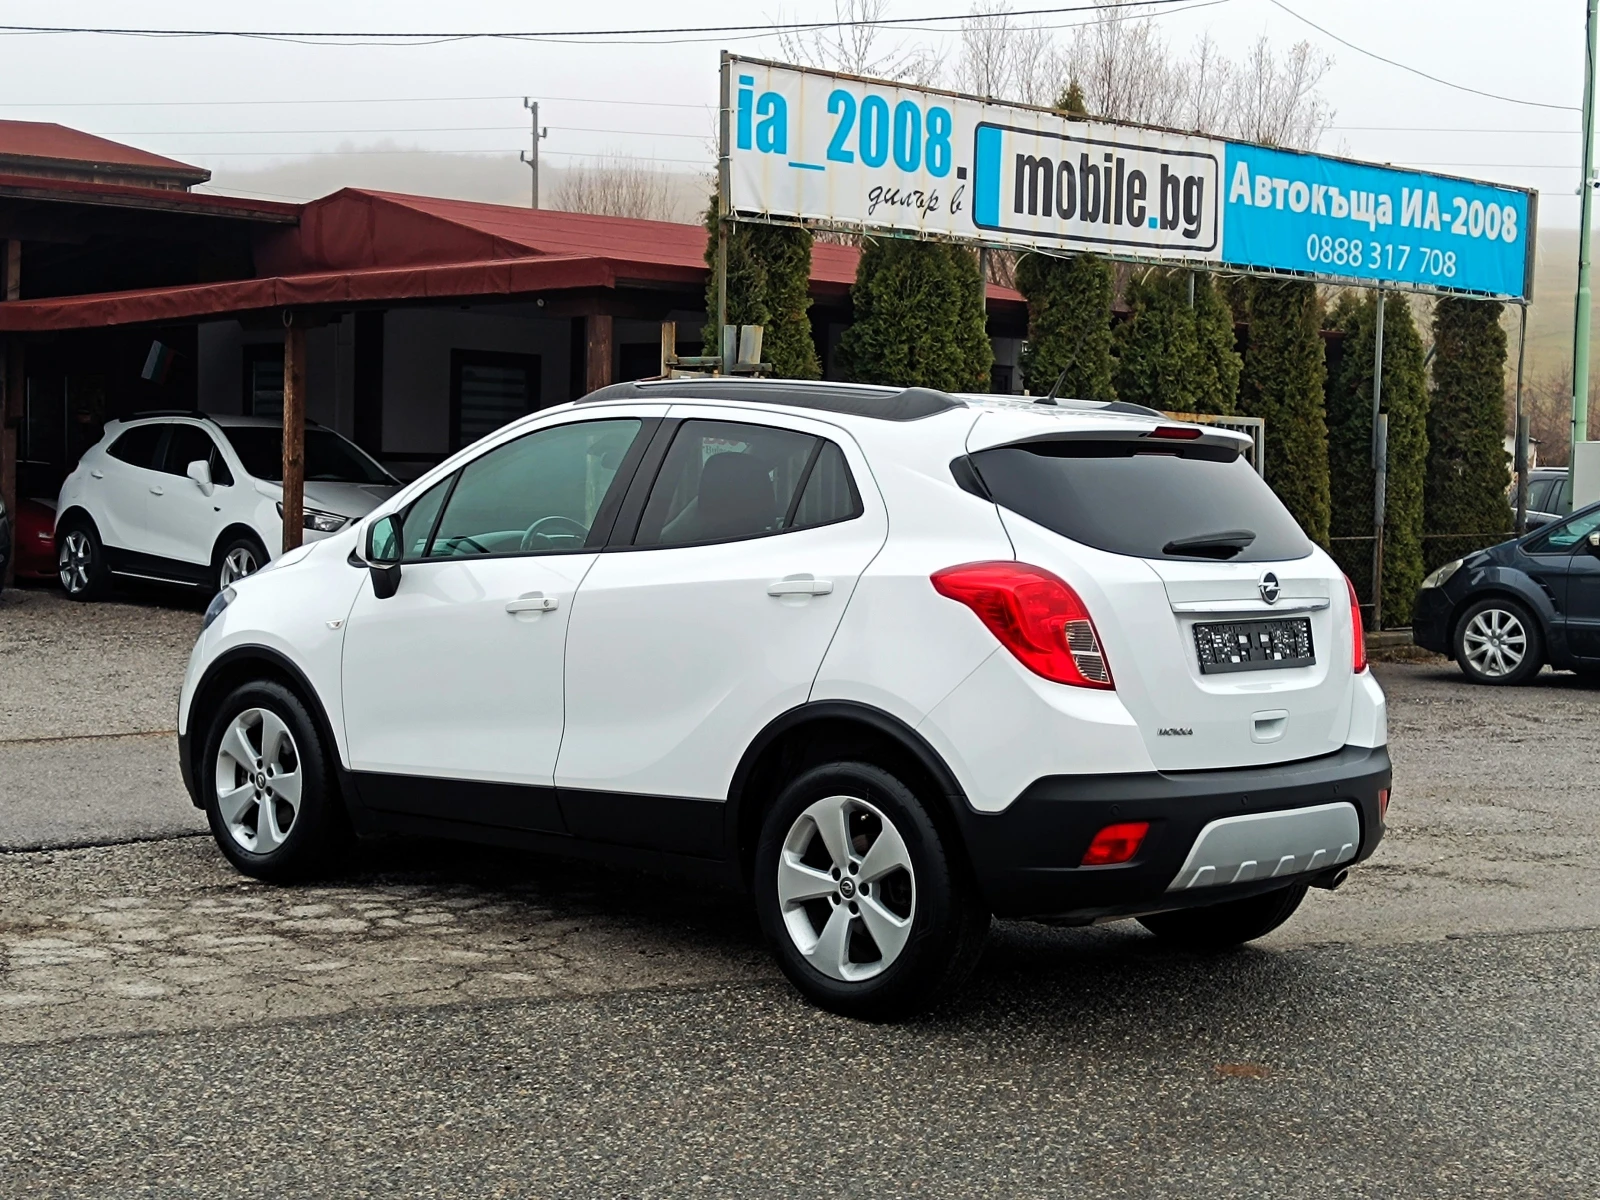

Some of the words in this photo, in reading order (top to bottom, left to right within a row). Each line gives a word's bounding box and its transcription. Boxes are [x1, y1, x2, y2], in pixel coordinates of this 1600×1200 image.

[1013, 153, 1204, 240] mobile.bg
[1228, 161, 1393, 232] Автокъща
[1400, 186, 1518, 243] ИА-2008
[1306, 233, 1363, 268] 0888
[1368, 241, 1411, 272] 317
[1418, 247, 1457, 278] 708
